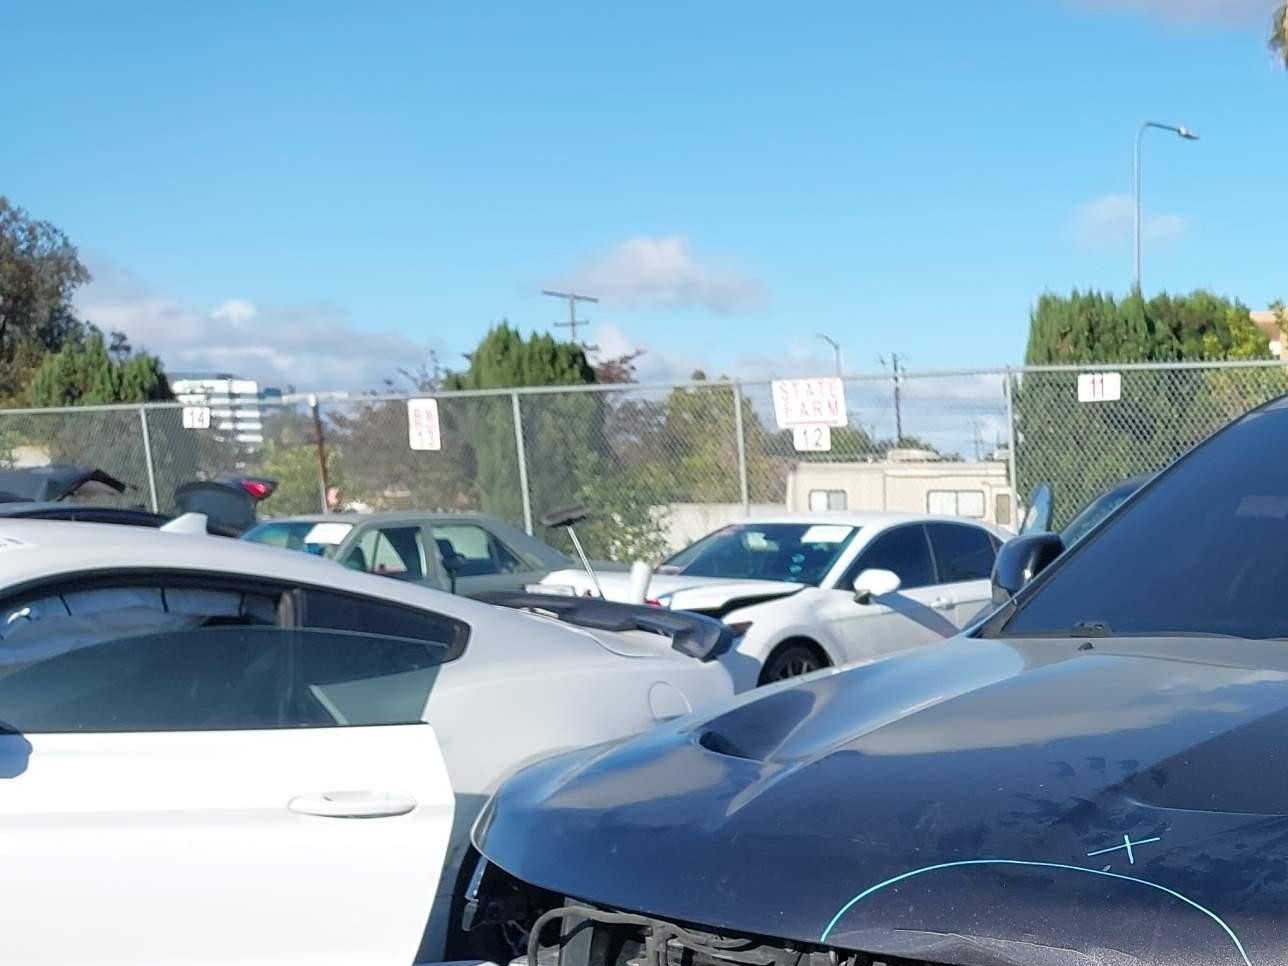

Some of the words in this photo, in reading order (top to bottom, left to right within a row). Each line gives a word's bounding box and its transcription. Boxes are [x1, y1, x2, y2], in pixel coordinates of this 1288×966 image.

[778, 380, 840, 400] STATE
[1090, 375, 1104, 399] 11
[783, 399, 840, 418] FARM
[189, 409, 206, 429] 14
[802, 427, 823, 449] 12
